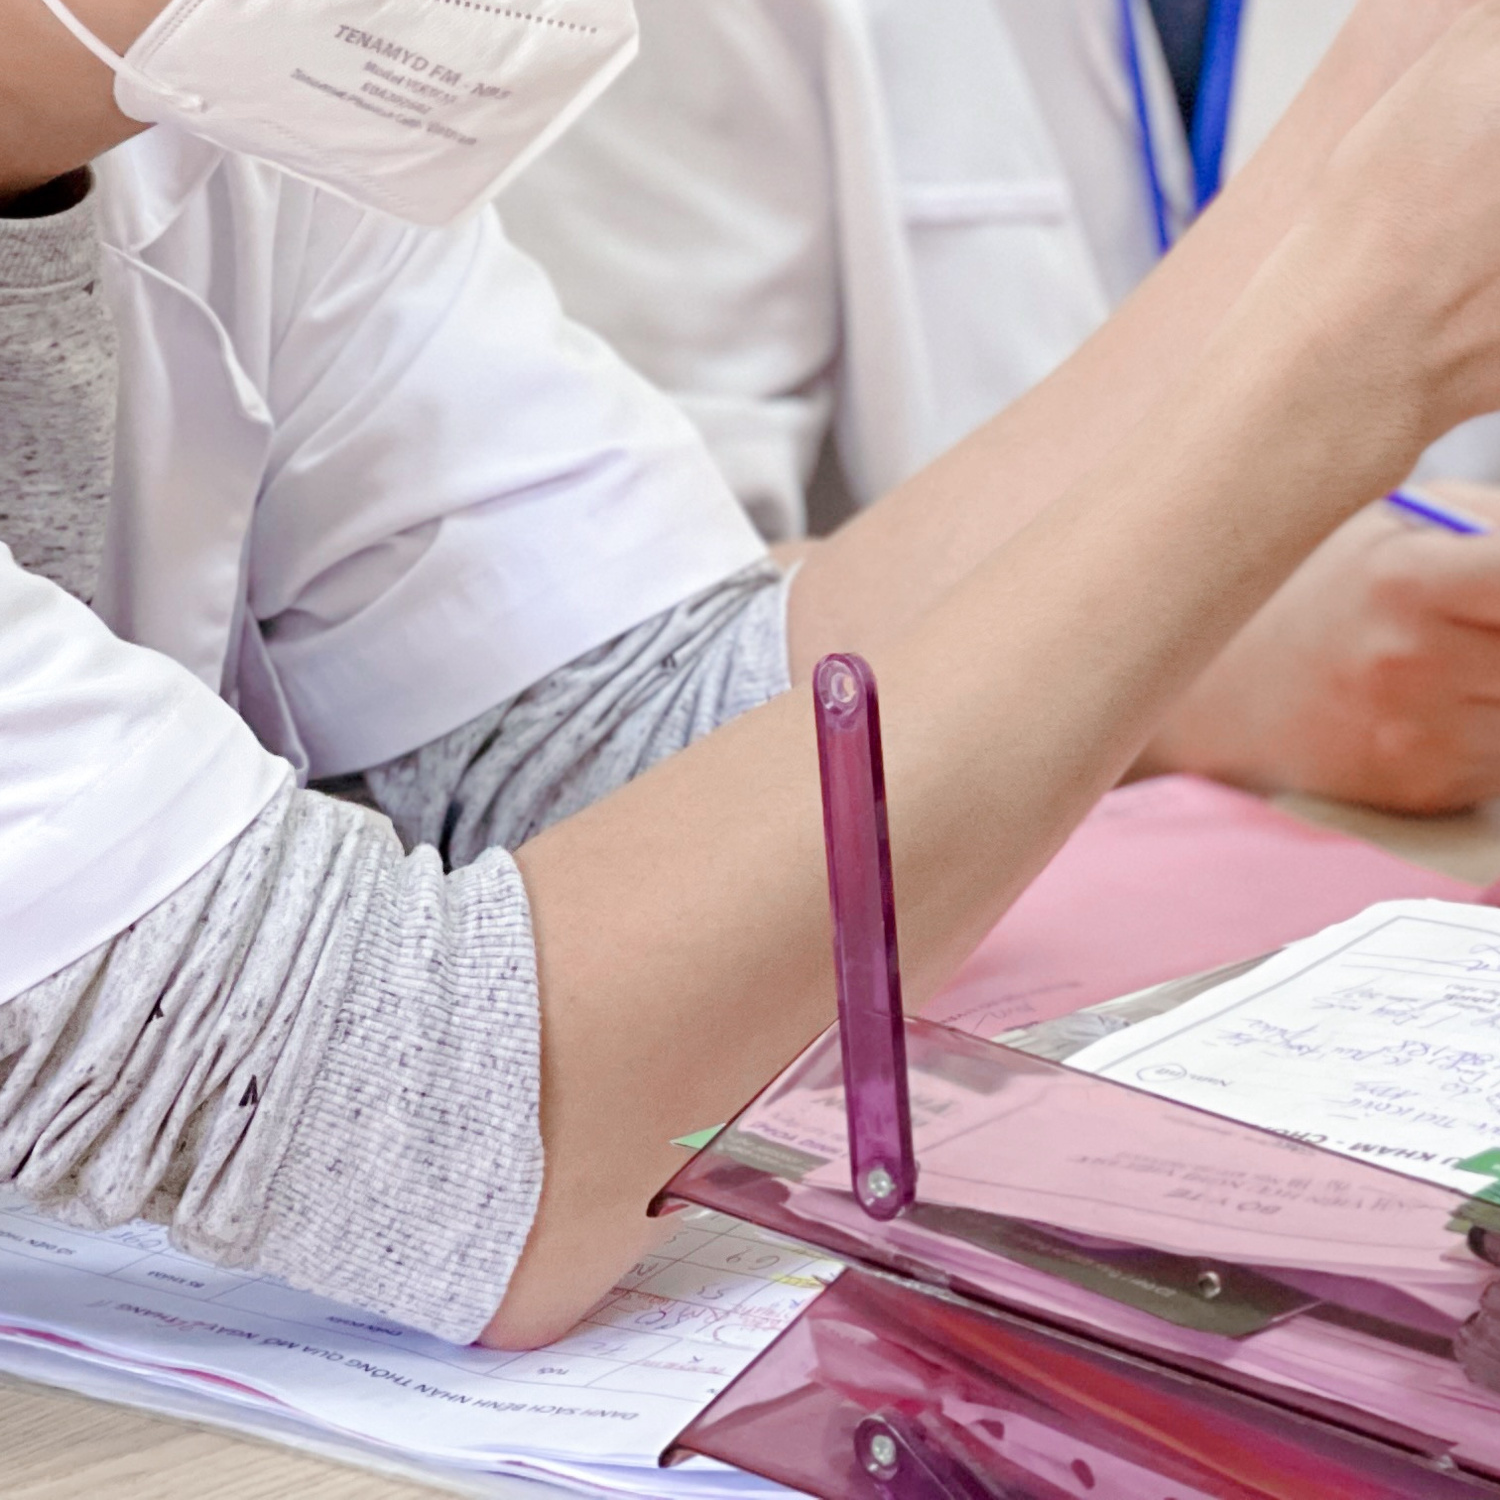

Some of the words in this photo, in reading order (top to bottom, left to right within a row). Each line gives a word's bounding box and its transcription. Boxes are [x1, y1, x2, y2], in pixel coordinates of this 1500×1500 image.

[334, 24, 430, 72] TENAMYD
[429, 64, 463, 87] FM
[301, 1344, 345, 1363] QUA
[347, 1357, 413, 1388] THÔNG
[579, 1408, 641, 1422] DANH
